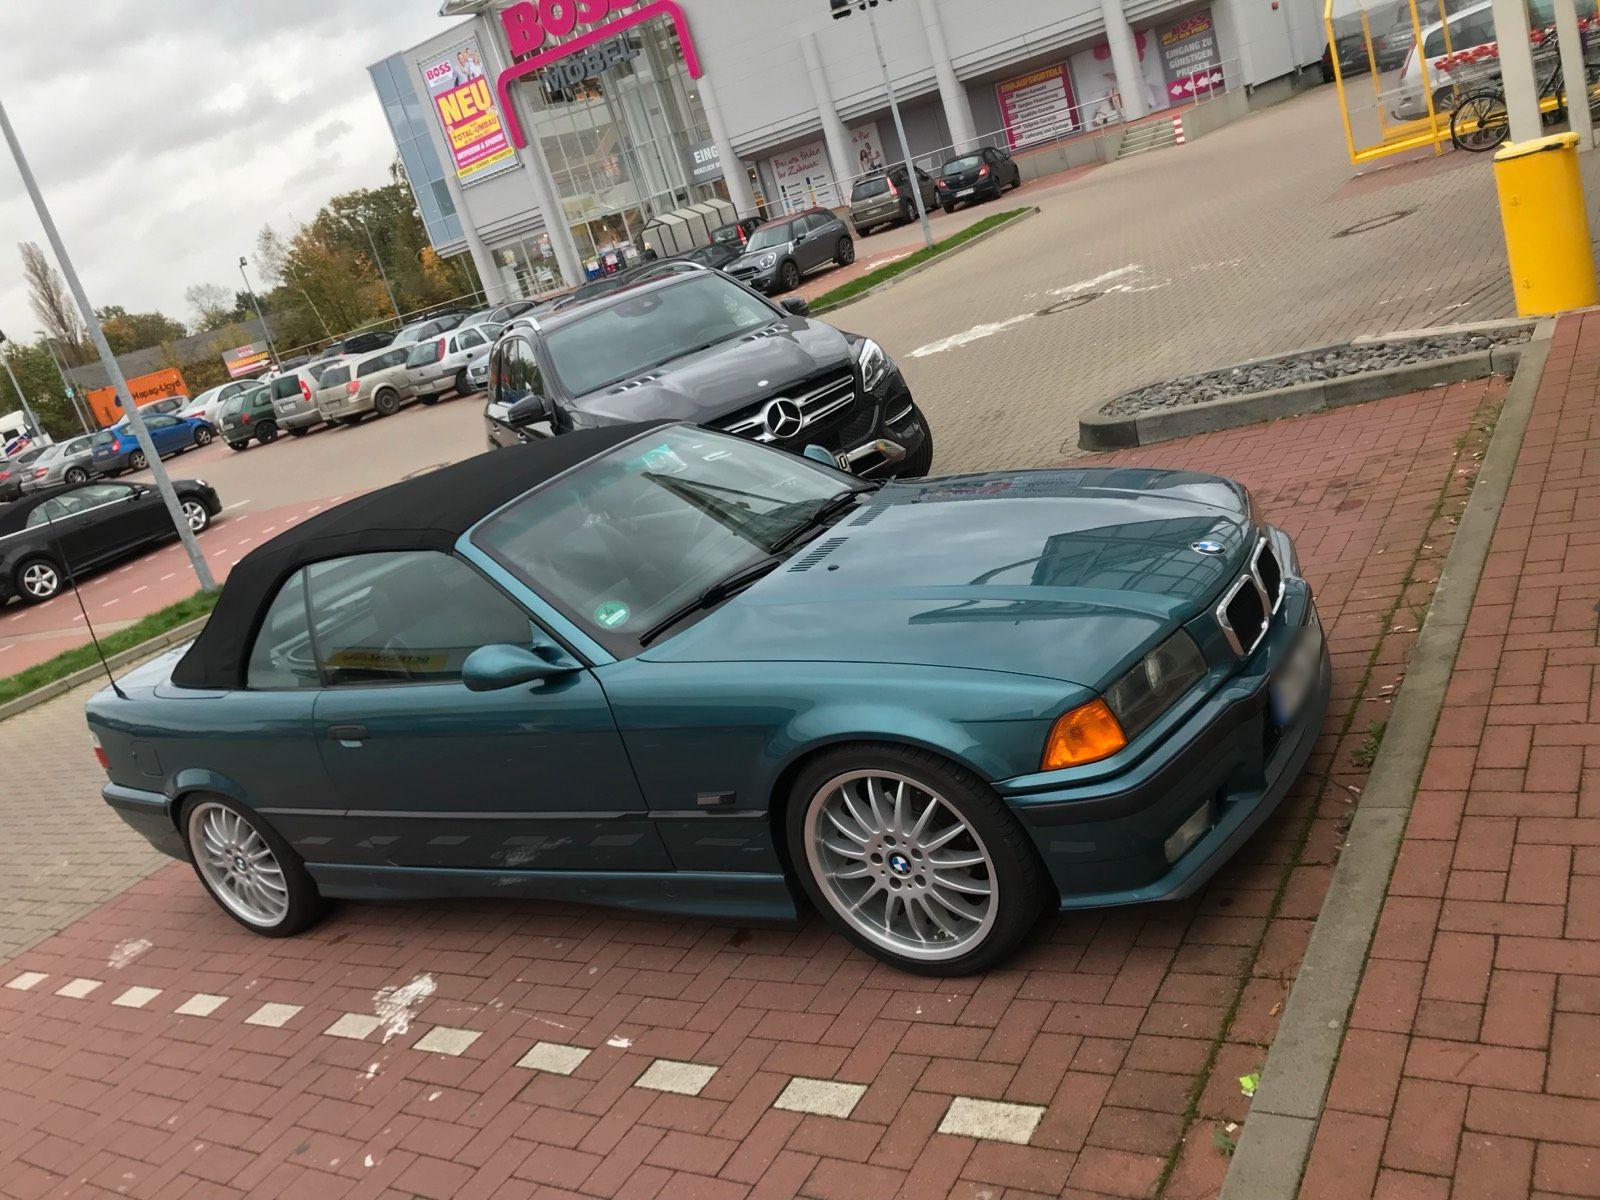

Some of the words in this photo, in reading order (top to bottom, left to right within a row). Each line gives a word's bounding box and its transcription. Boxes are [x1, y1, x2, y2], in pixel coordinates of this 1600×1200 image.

[1166, 41, 1200, 59] EINGANG
[1202, 37, 1212, 48] ZU
[1169, 48, 1212, 69] GÜNSTIGEN
[426, 62, 451, 80] BOSS
[1176, 61, 1209, 77] PREISEN
[438, 79, 491, 125] NEU
[132, 379, 181, 400] Hapag-Lloyd
